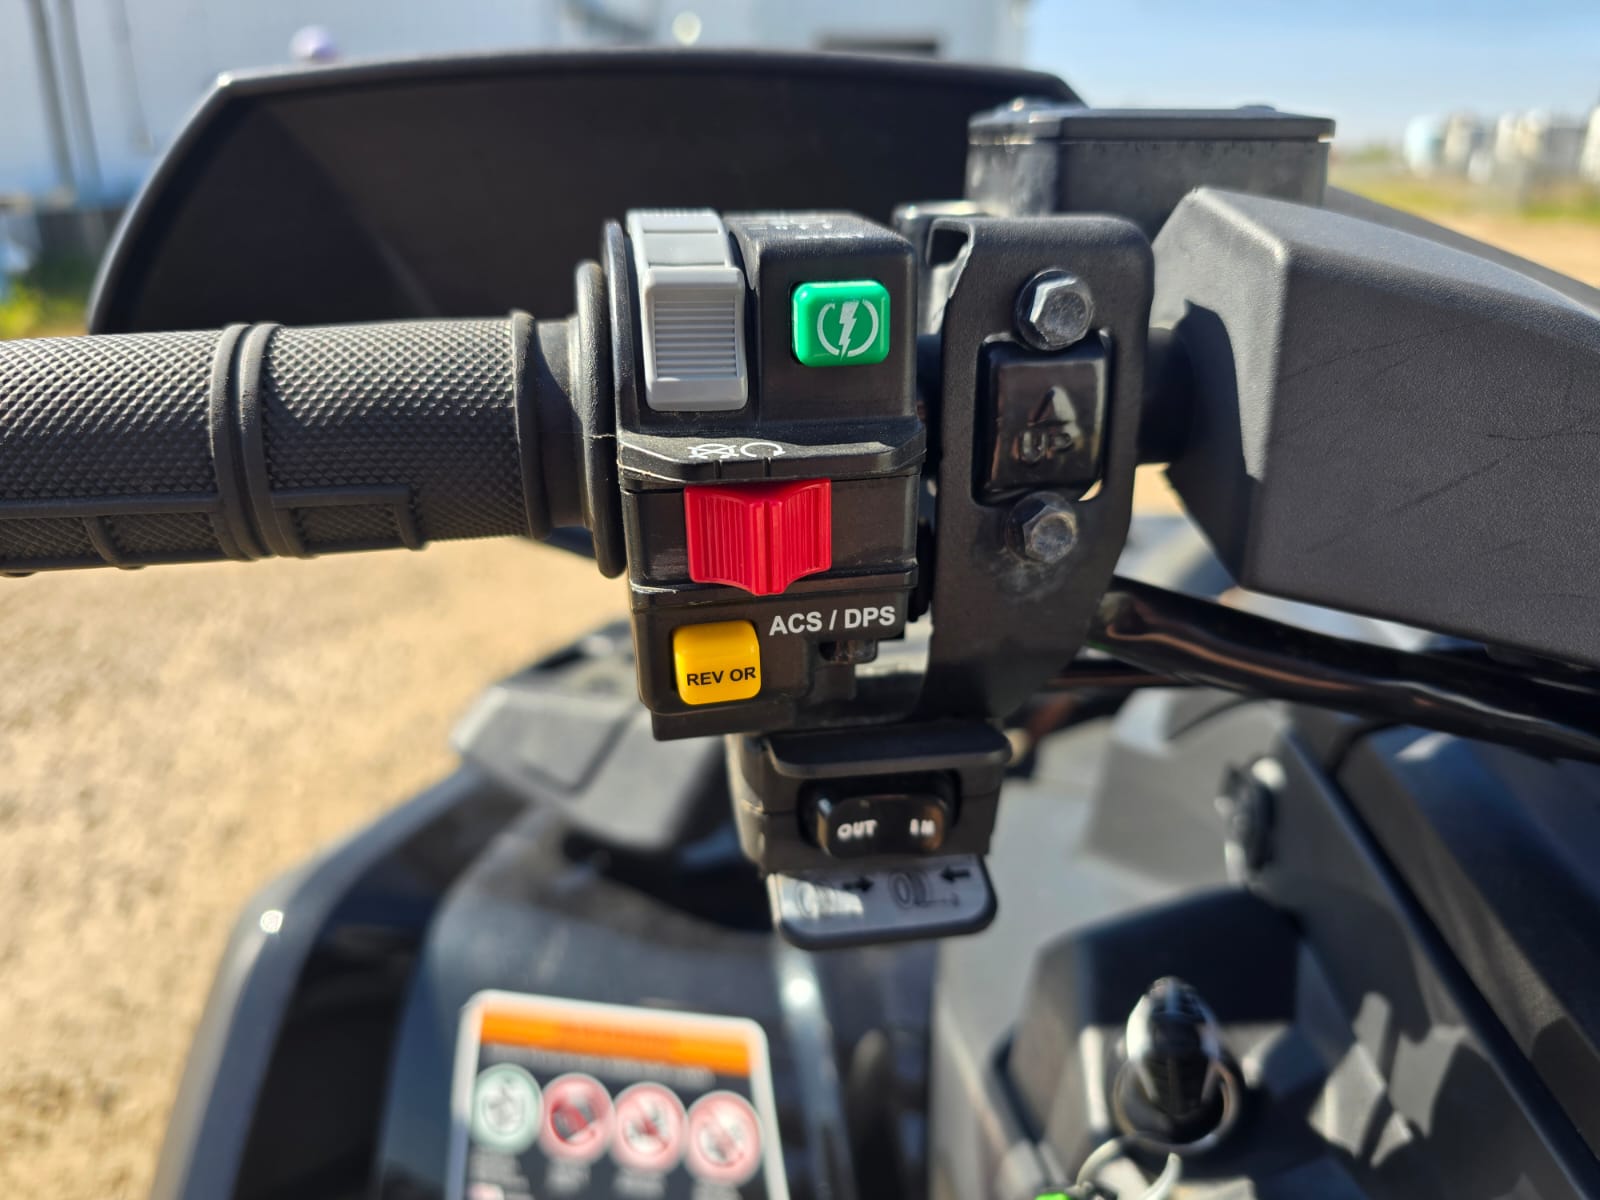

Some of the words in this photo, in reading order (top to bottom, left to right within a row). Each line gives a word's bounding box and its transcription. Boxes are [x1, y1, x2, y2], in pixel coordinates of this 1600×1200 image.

[1014, 429, 1074, 463] UP
[768, 611, 823, 636] ACS
[828, 609, 838, 631] /
[844, 605, 896, 629] DPS
[686, 670, 725, 686] REV
[729, 666, 757, 682] OR
[837, 819, 878, 841] OUT
[909, 818, 936, 836] IN
